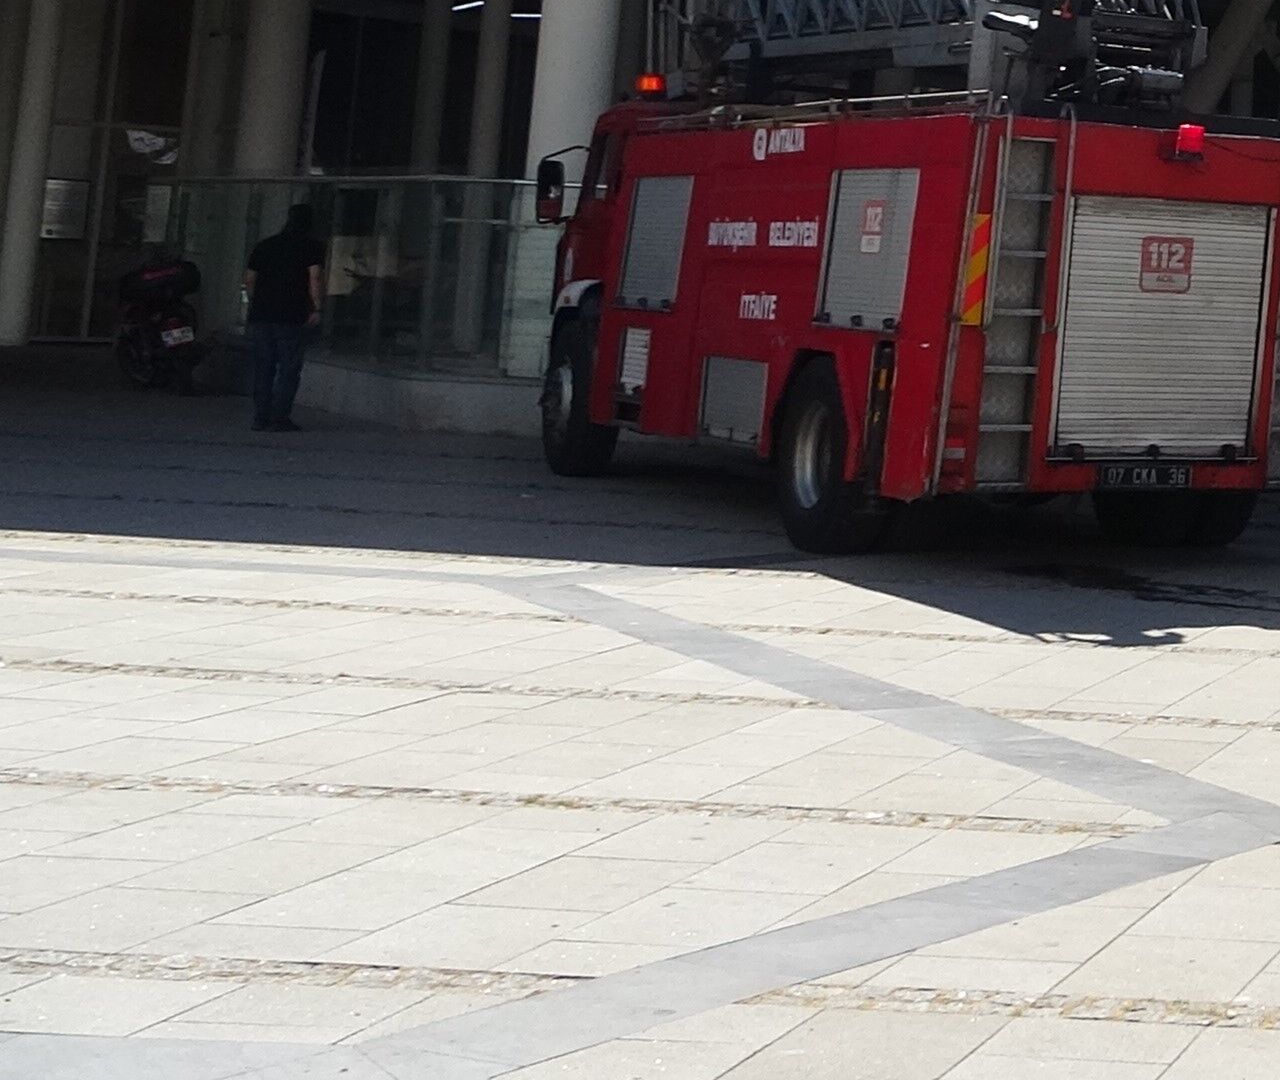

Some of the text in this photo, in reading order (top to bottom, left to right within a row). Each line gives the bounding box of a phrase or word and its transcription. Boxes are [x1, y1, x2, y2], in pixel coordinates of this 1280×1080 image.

[1149, 242, 1186, 269] 112
[1107, 467, 1186, 484] 07 CKA 36
